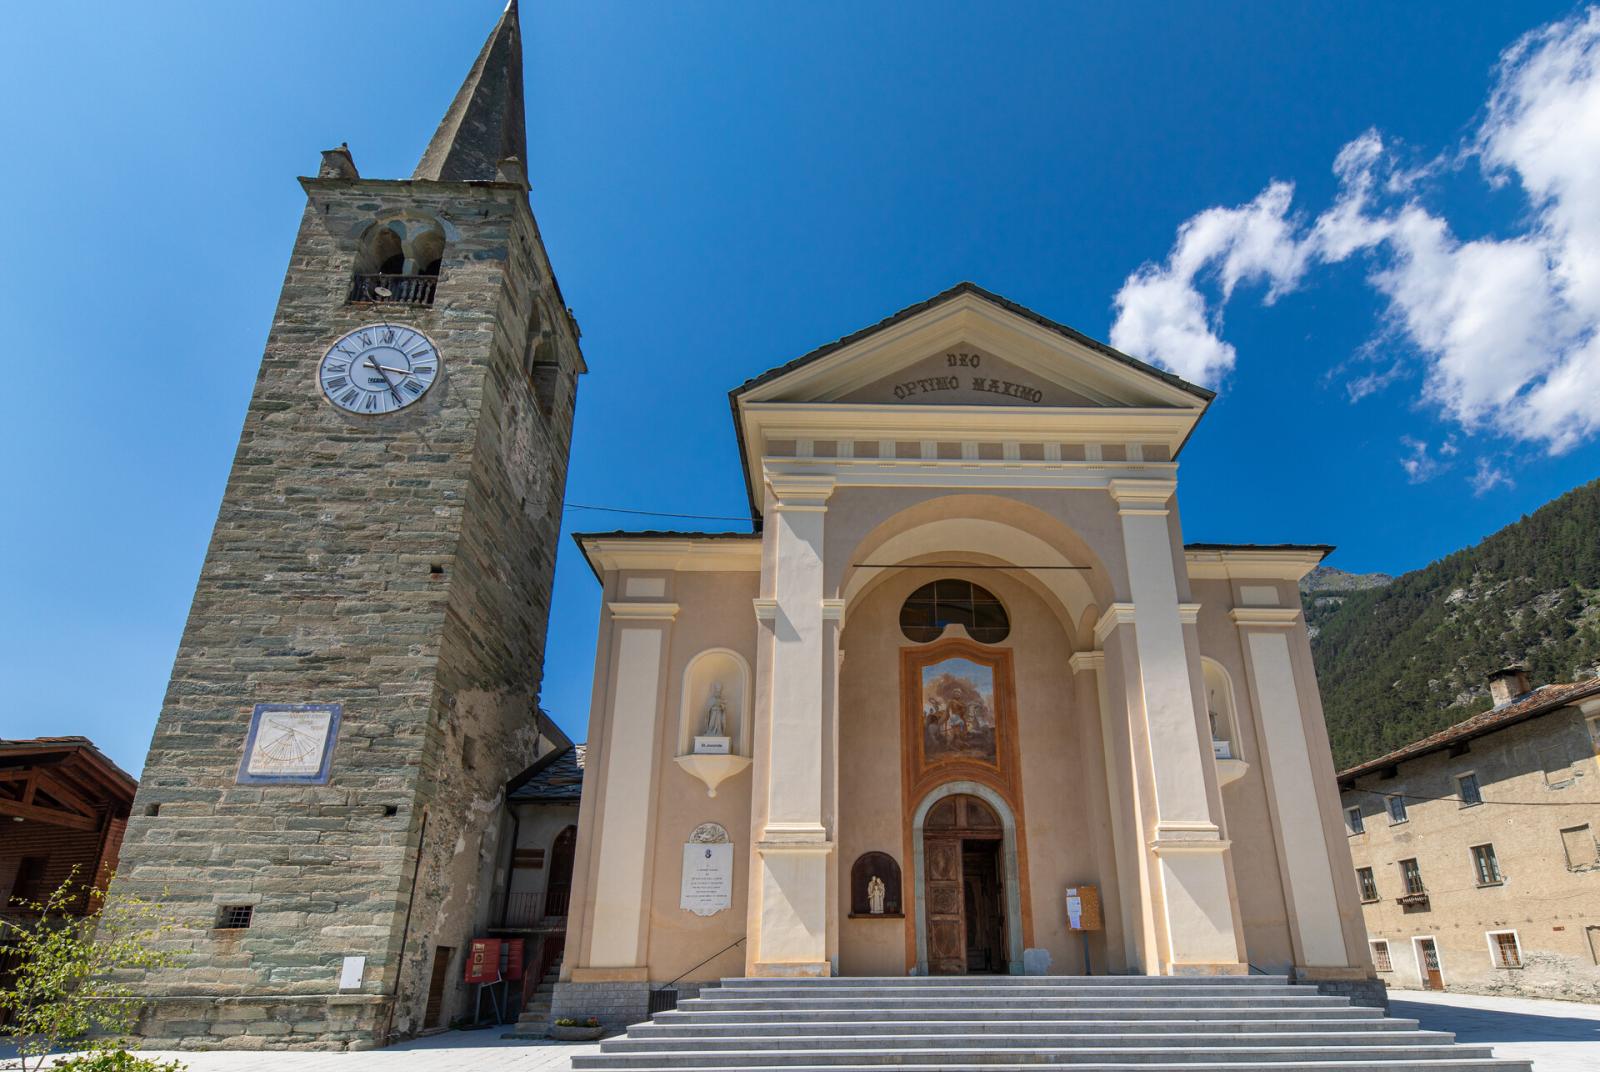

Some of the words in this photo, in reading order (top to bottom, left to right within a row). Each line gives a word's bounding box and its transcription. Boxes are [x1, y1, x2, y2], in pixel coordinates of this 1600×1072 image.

[358, 333, 372, 347] XI
[338, 346, 355, 358] X
[946, 353, 980, 368] DEO
[327, 364, 346, 373] IX
[893, 375, 960, 400] OPTIMO
[971, 377, 1043, 403] MAXIMO
